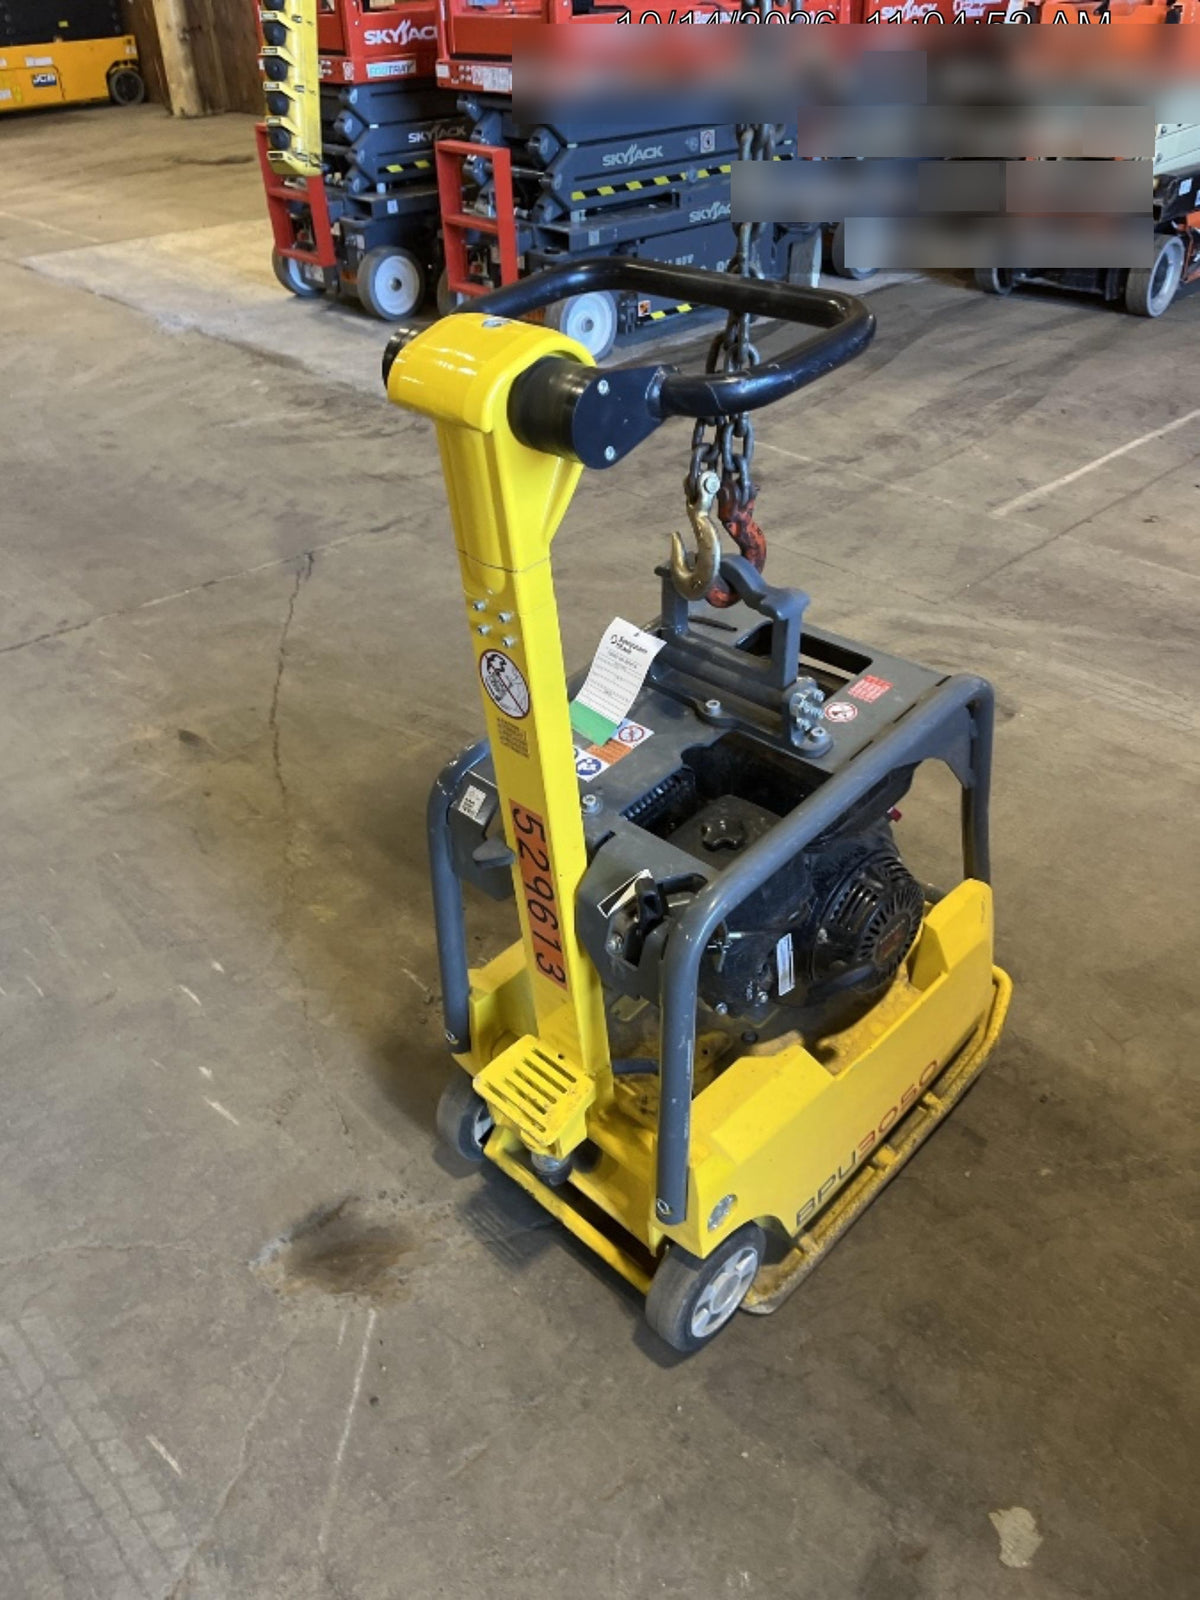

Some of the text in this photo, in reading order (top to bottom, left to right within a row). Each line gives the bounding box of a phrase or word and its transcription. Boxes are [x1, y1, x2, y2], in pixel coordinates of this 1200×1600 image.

[602, 143, 664, 167] SKYJACK
[688, 201, 732, 223] SKYJAC
[512, 807, 567, 984] 529613
